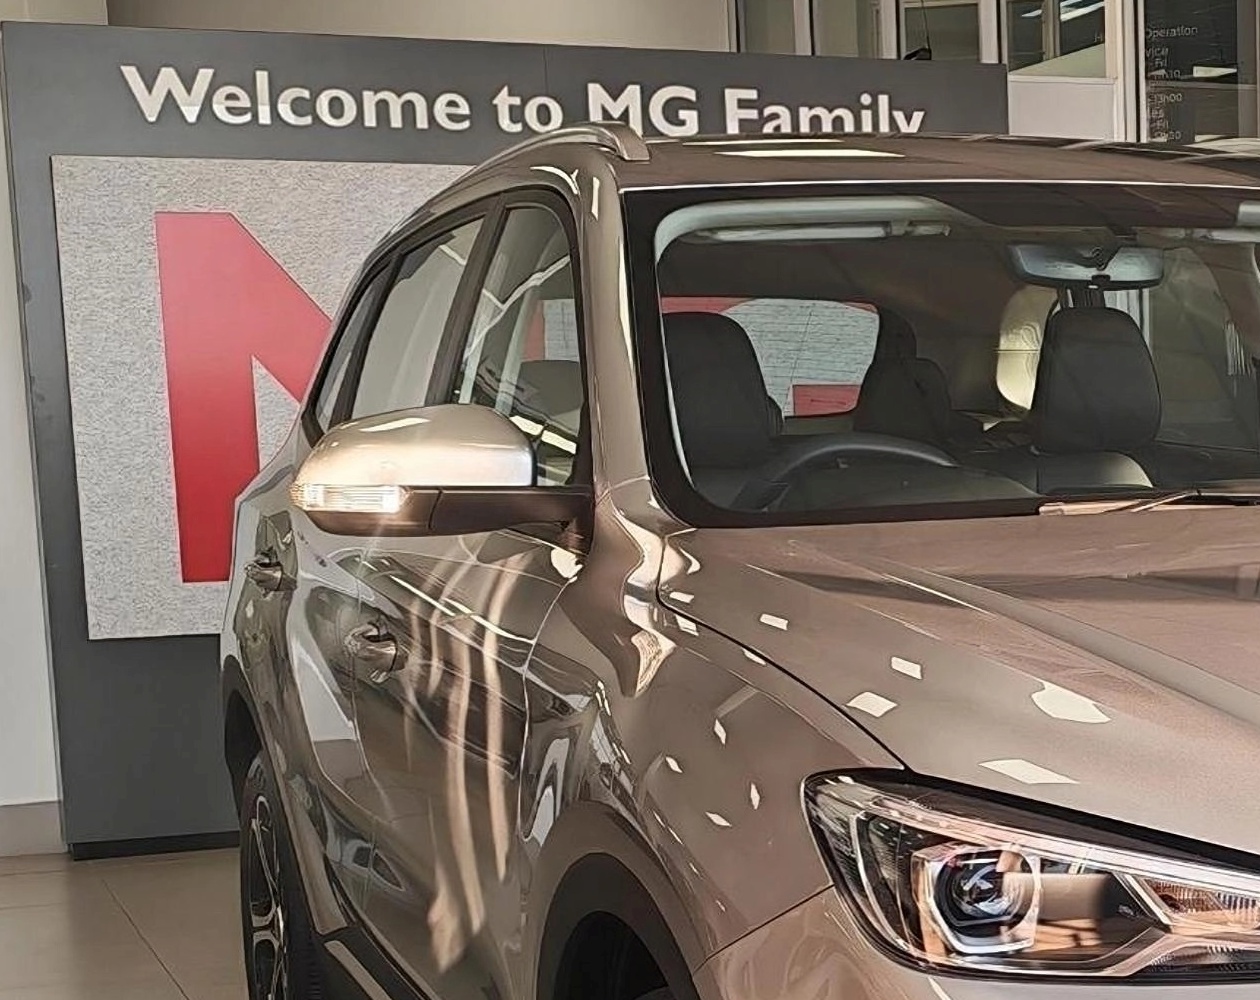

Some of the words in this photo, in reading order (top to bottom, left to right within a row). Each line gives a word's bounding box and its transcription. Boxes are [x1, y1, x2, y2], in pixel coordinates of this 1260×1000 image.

[119, 65, 472, 131] Welcome
[492, 85, 564, 133] to
[586, 83, 699, 137] MG
[724, 88, 926, 134] Family
